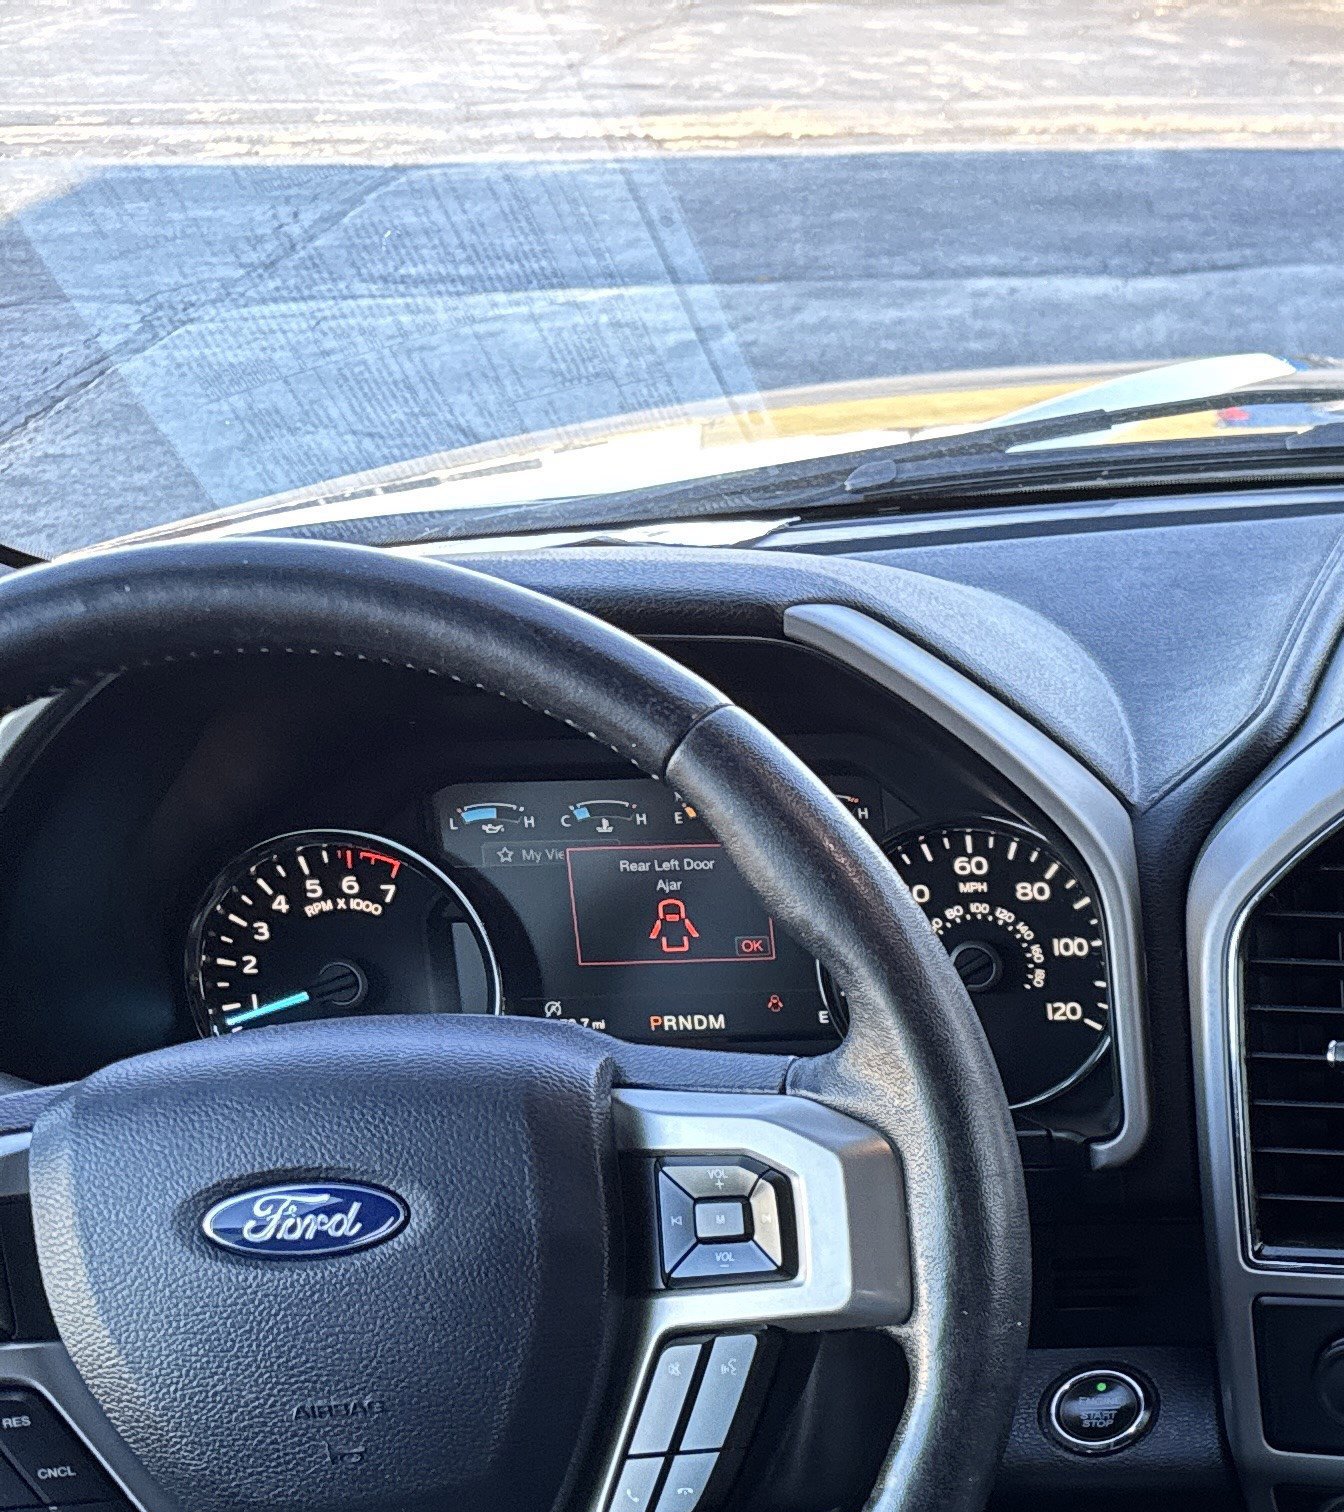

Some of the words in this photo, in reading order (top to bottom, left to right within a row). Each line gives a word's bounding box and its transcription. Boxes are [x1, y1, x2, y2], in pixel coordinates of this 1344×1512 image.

[636, 813, 646, 826] H
[674, 812, 683, 824] E
[858, 808, 868, 820] H
[450, 818, 458, 830] L
[524, 816, 535, 828] H
[561, 816, 571, 828] C
[522, 848, 547, 863] My
[549, 848, 566, 861] Vie
[620, 859, 651, 872] Rear
[654, 858, 677, 871] Left
[680, 858, 715, 870] Door
[954, 857, 988, 875] 60
[306, 880, 322, 897] 5
[342, 876, 359, 893] 6
[656, 879, 682, 894] Ajar
[959, 883, 988, 894] MPH
[380, 885, 397, 903] 7
[909, 885, 930, 903] 0
[1015, 883, 1050, 901] 80
[271, 896, 289, 913] 4
[304, 900, 332, 918] RPM
[349, 899, 383, 917] 1000
[970, 903, 990, 914] 100
[945, 906, 964, 919] 80
[995, 907, 1015, 923] 120
[253, 922, 270, 940] 3
[741, 940, 763, 952] OK
[1053, 938, 1088, 956] 100
[242, 956, 259, 973] 2
[252, 993, 258, 1009] 1
[818, 1011, 829, 1024] E
[1047, 1003, 1082, 1021] 120
[650, 1014, 726, 1031] PRNDM
[708, 1169, 728, 1179] VOL
[243, 1193, 362, 1243] Ford
[715, 1252, 735, 1261] VOL
[2, 1416, 31, 1428] RES
[1080, 1411, 1117, 1419] START
[1082, 1420, 1114, 1428] STOP
[38, 1466, 76, 1479] CNCL
